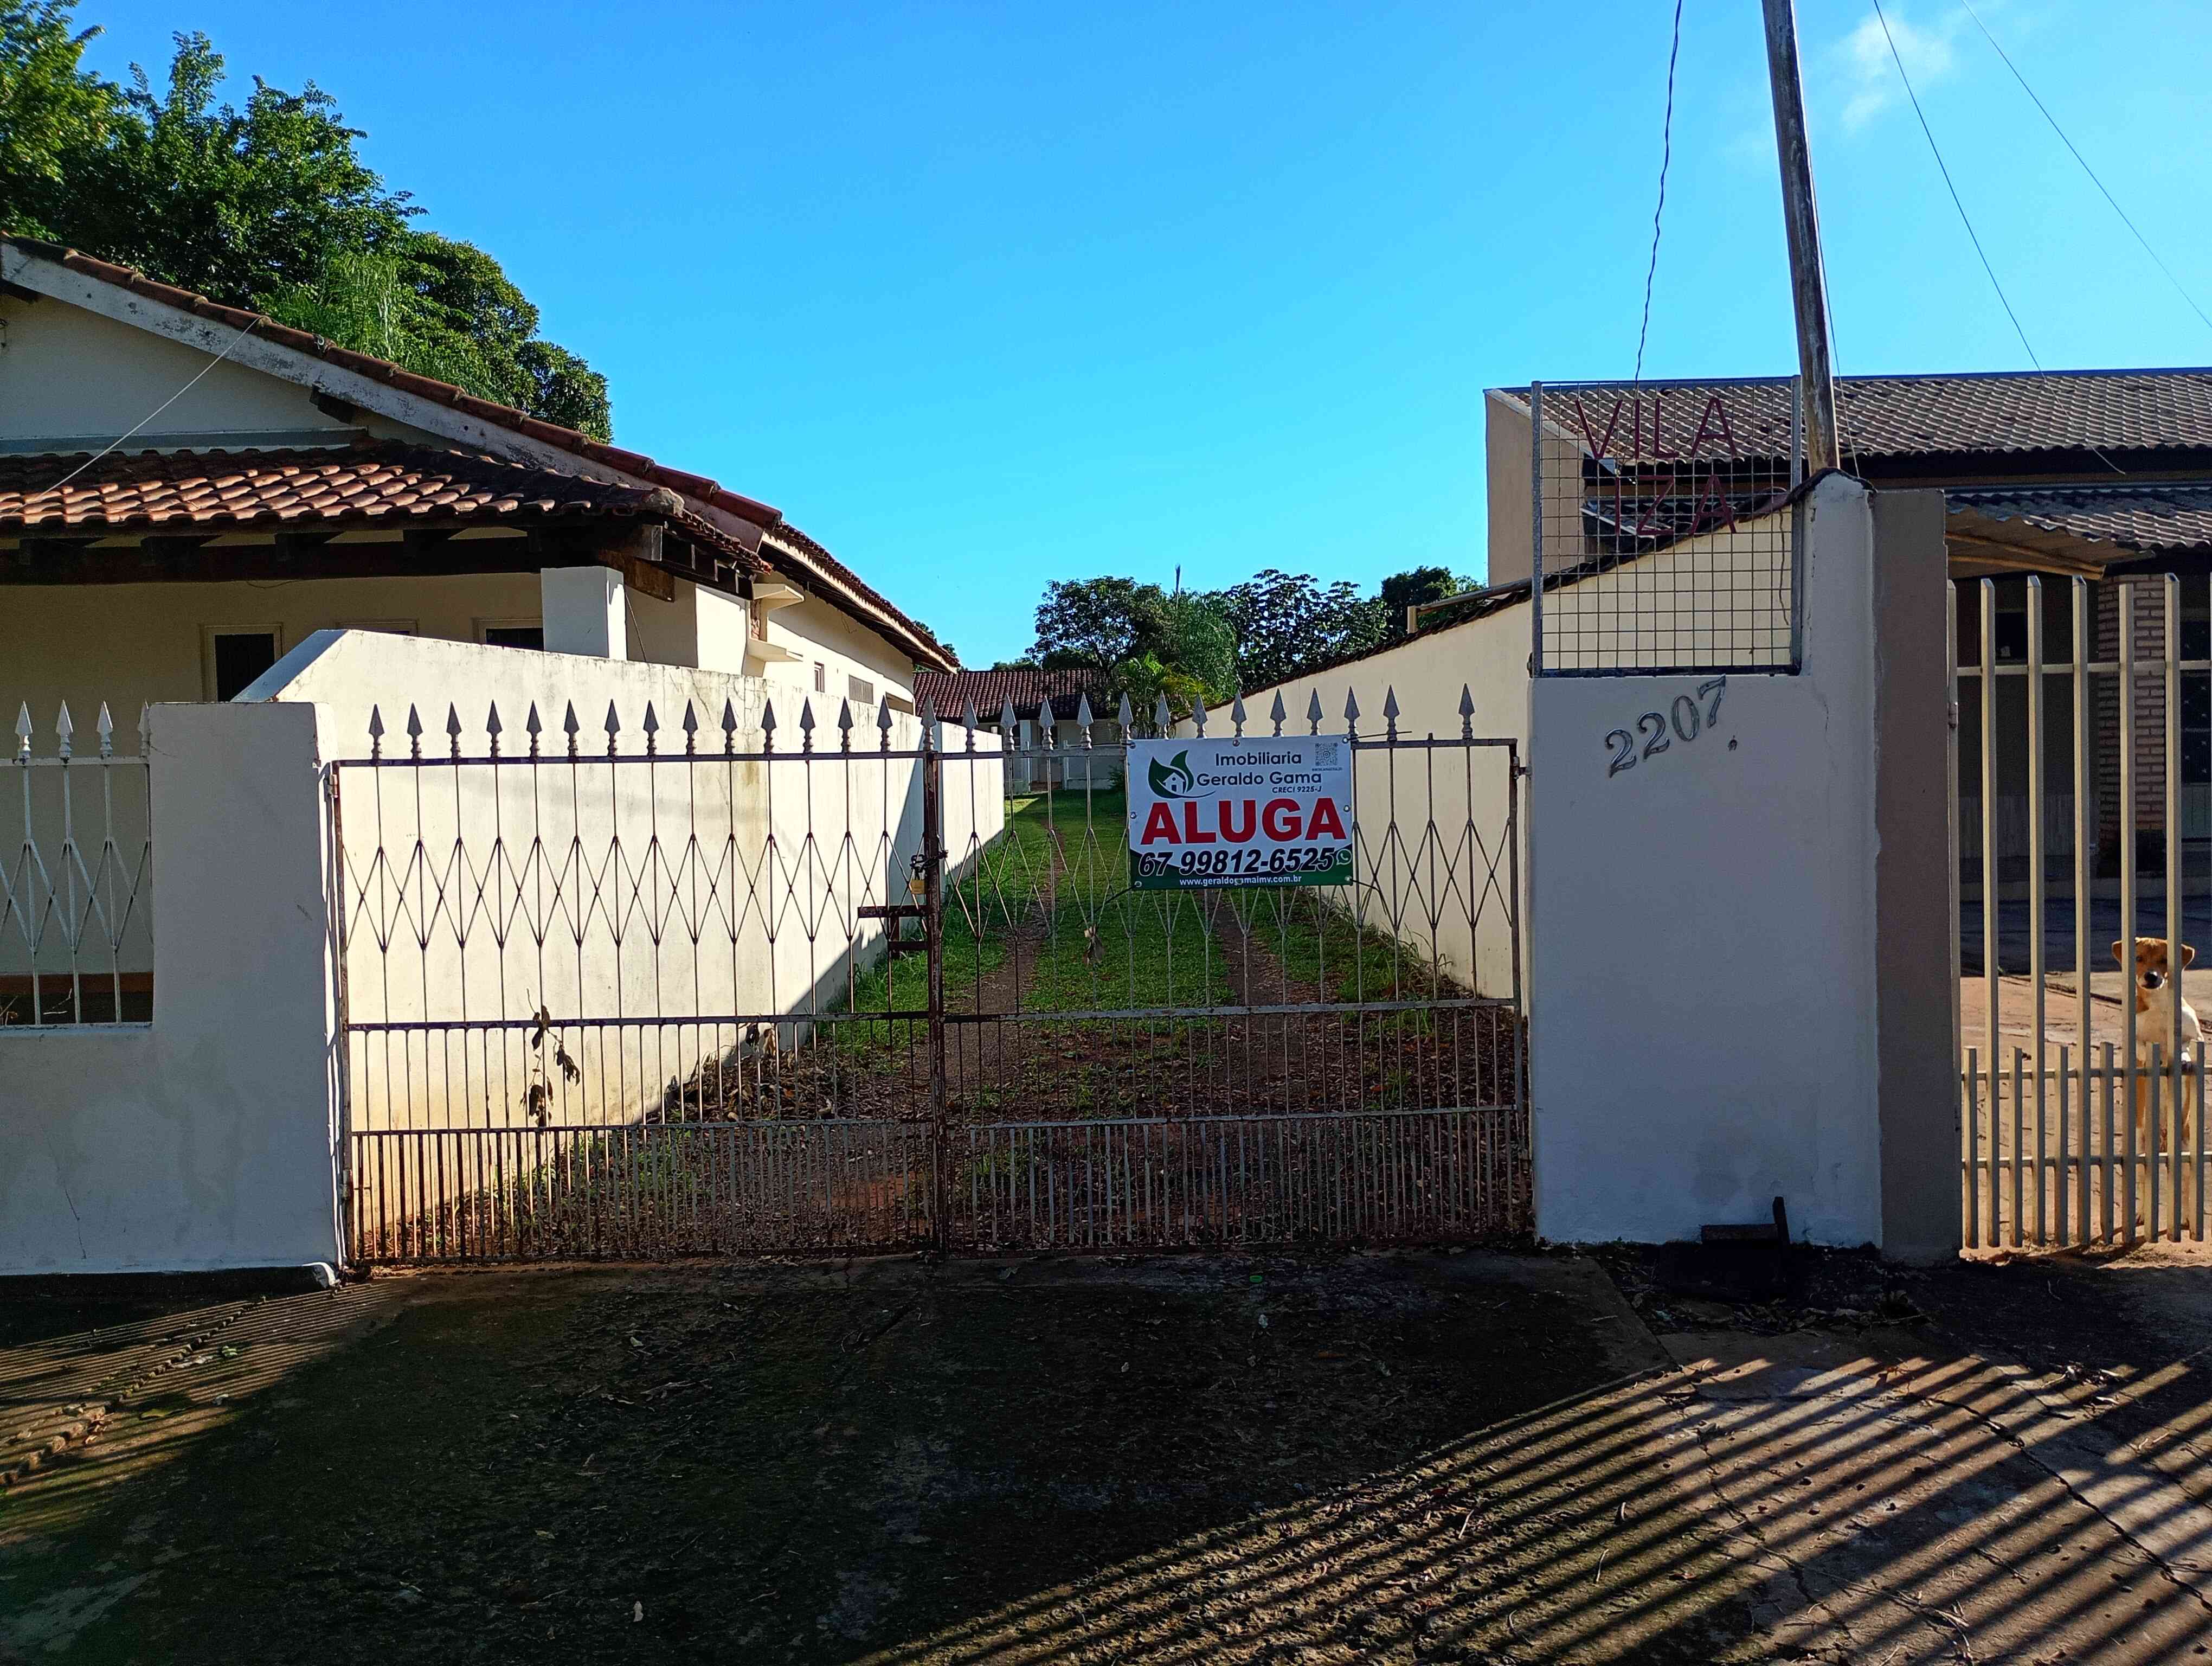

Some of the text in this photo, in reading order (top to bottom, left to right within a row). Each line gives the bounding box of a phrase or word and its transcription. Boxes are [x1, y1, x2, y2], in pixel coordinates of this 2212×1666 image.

[1575, 397, 1737, 459] VILA
[1605, 674, 1726, 778] 2207
[1215, 751, 1302, 766] Imobiliaria
[1197, 771, 1322, 786] Geraldo Gama
[1140, 798, 1347, 845] ALUGA
[1139, 847, 1336, 877] 67 99812-6525
